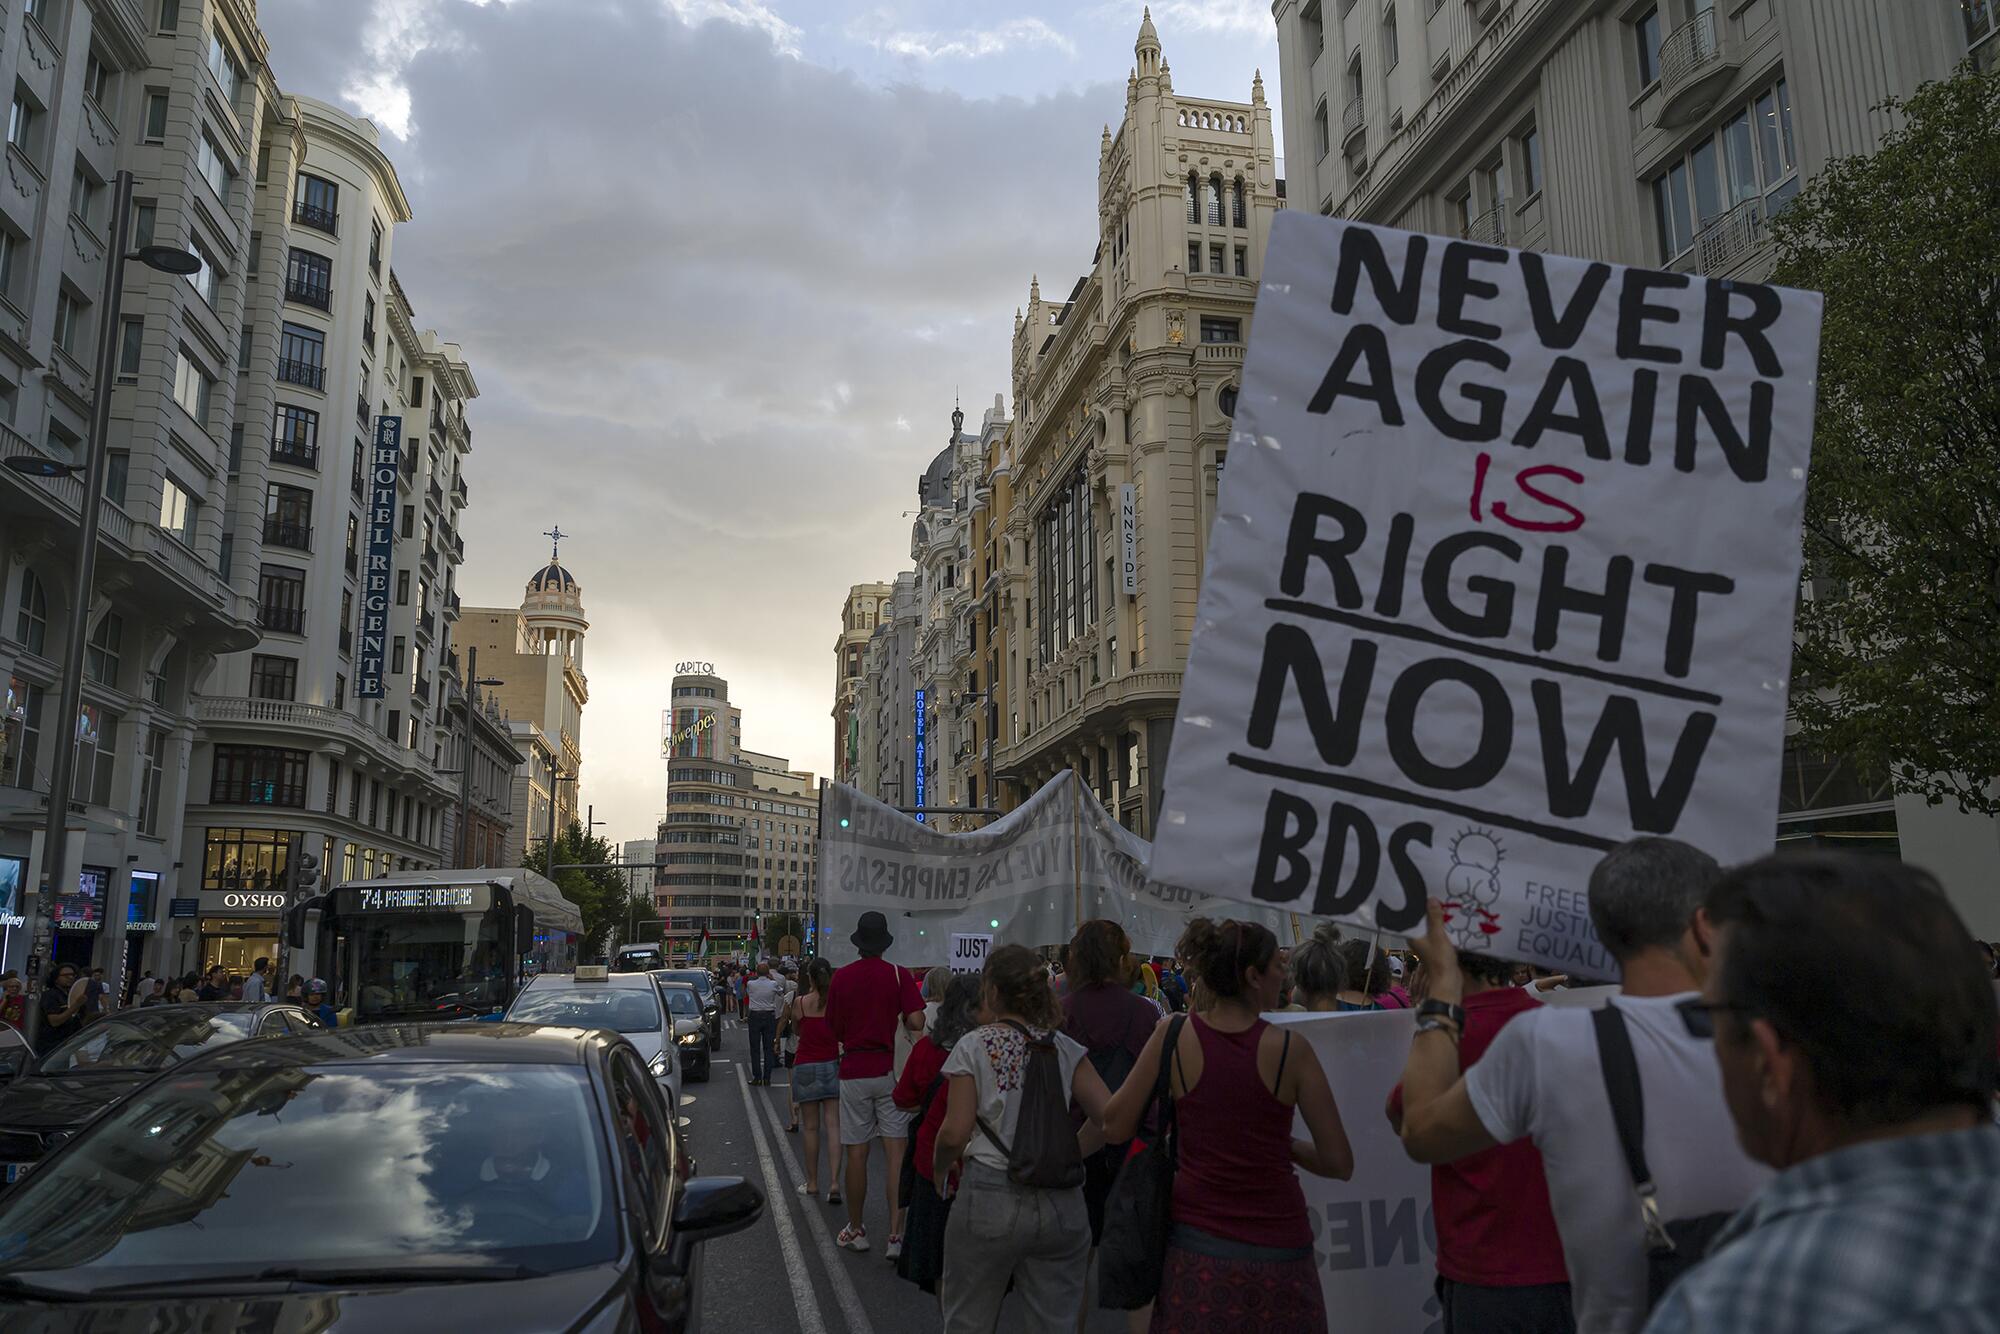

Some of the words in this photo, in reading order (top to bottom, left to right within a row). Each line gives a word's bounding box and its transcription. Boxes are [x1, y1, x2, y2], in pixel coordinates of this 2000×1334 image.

[1331, 226, 1784, 378] NEVER
[1307, 324, 1774, 483] AGAIN
[373, 448, 398, 545] HOTEL
[1469, 452, 1586, 533] IS
[361, 554, 388, 695] REGENTE
[1279, 491, 1736, 679] RIGHT
[675, 661, 716, 675] CAPITOL
[916, 691, 925, 736] HOTEL
[1247, 622, 1718, 835] NOW
[224, 893, 285, 908] OYSHO
[360, 889, 383, 910] 74
[1251, 789, 1434, 931] BDS
[0, 912, 26, 929] Money
[59, 919, 100, 930] SKECHERS
[956, 938, 989, 958] JUST
